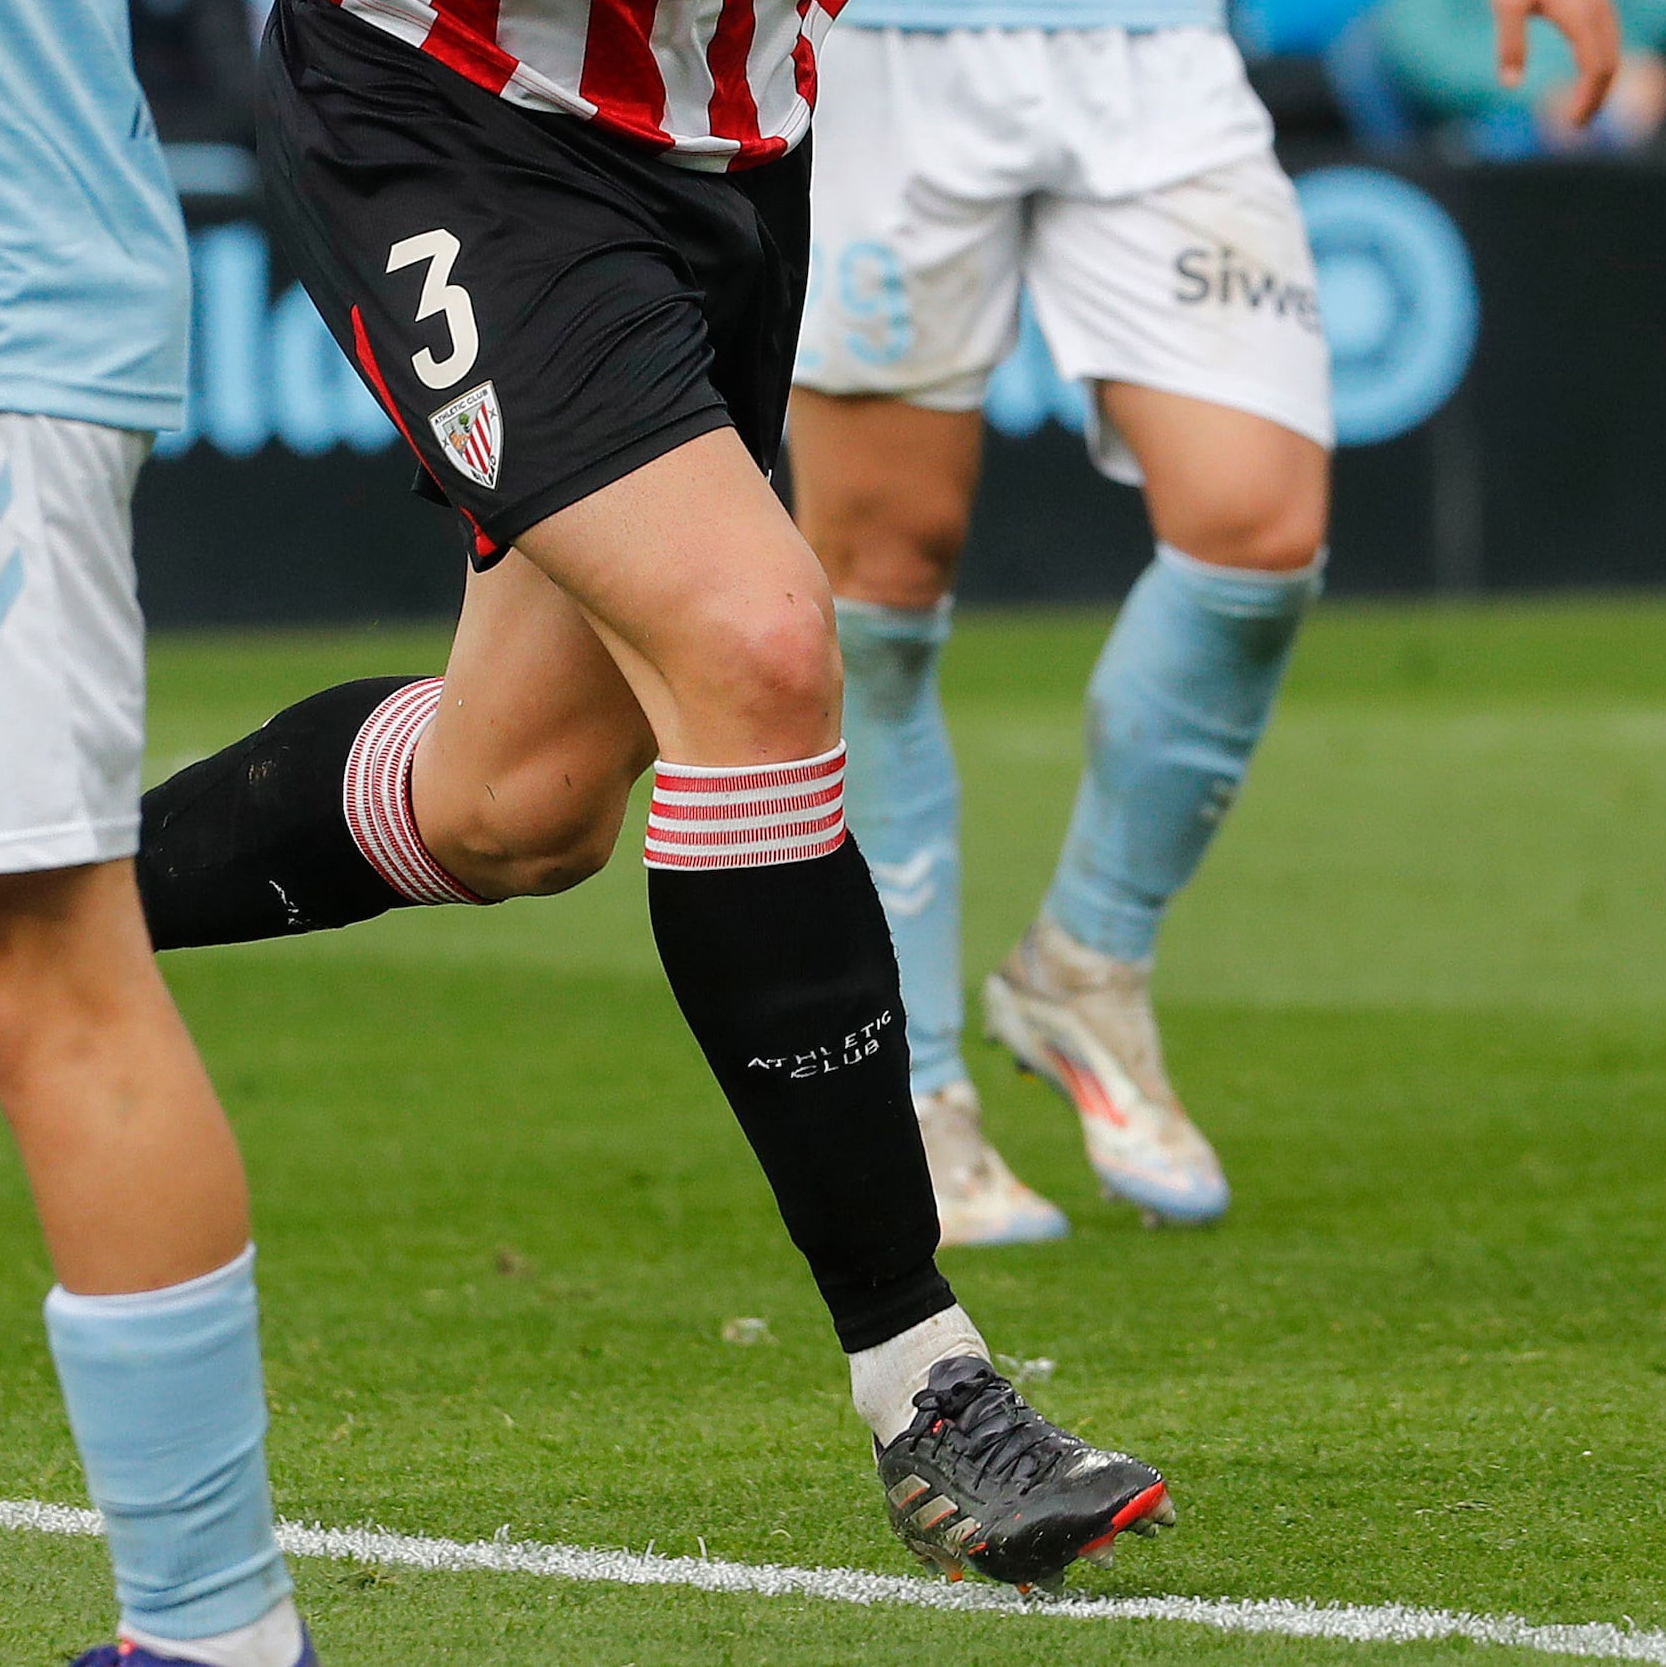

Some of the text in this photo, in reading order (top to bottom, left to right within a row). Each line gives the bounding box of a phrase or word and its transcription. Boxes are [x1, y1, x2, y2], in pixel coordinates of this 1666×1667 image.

[385, 228, 480, 391] 3
[433, 400, 468, 425] ATHLETIC
[790, 1038, 881, 1079] CLUB
